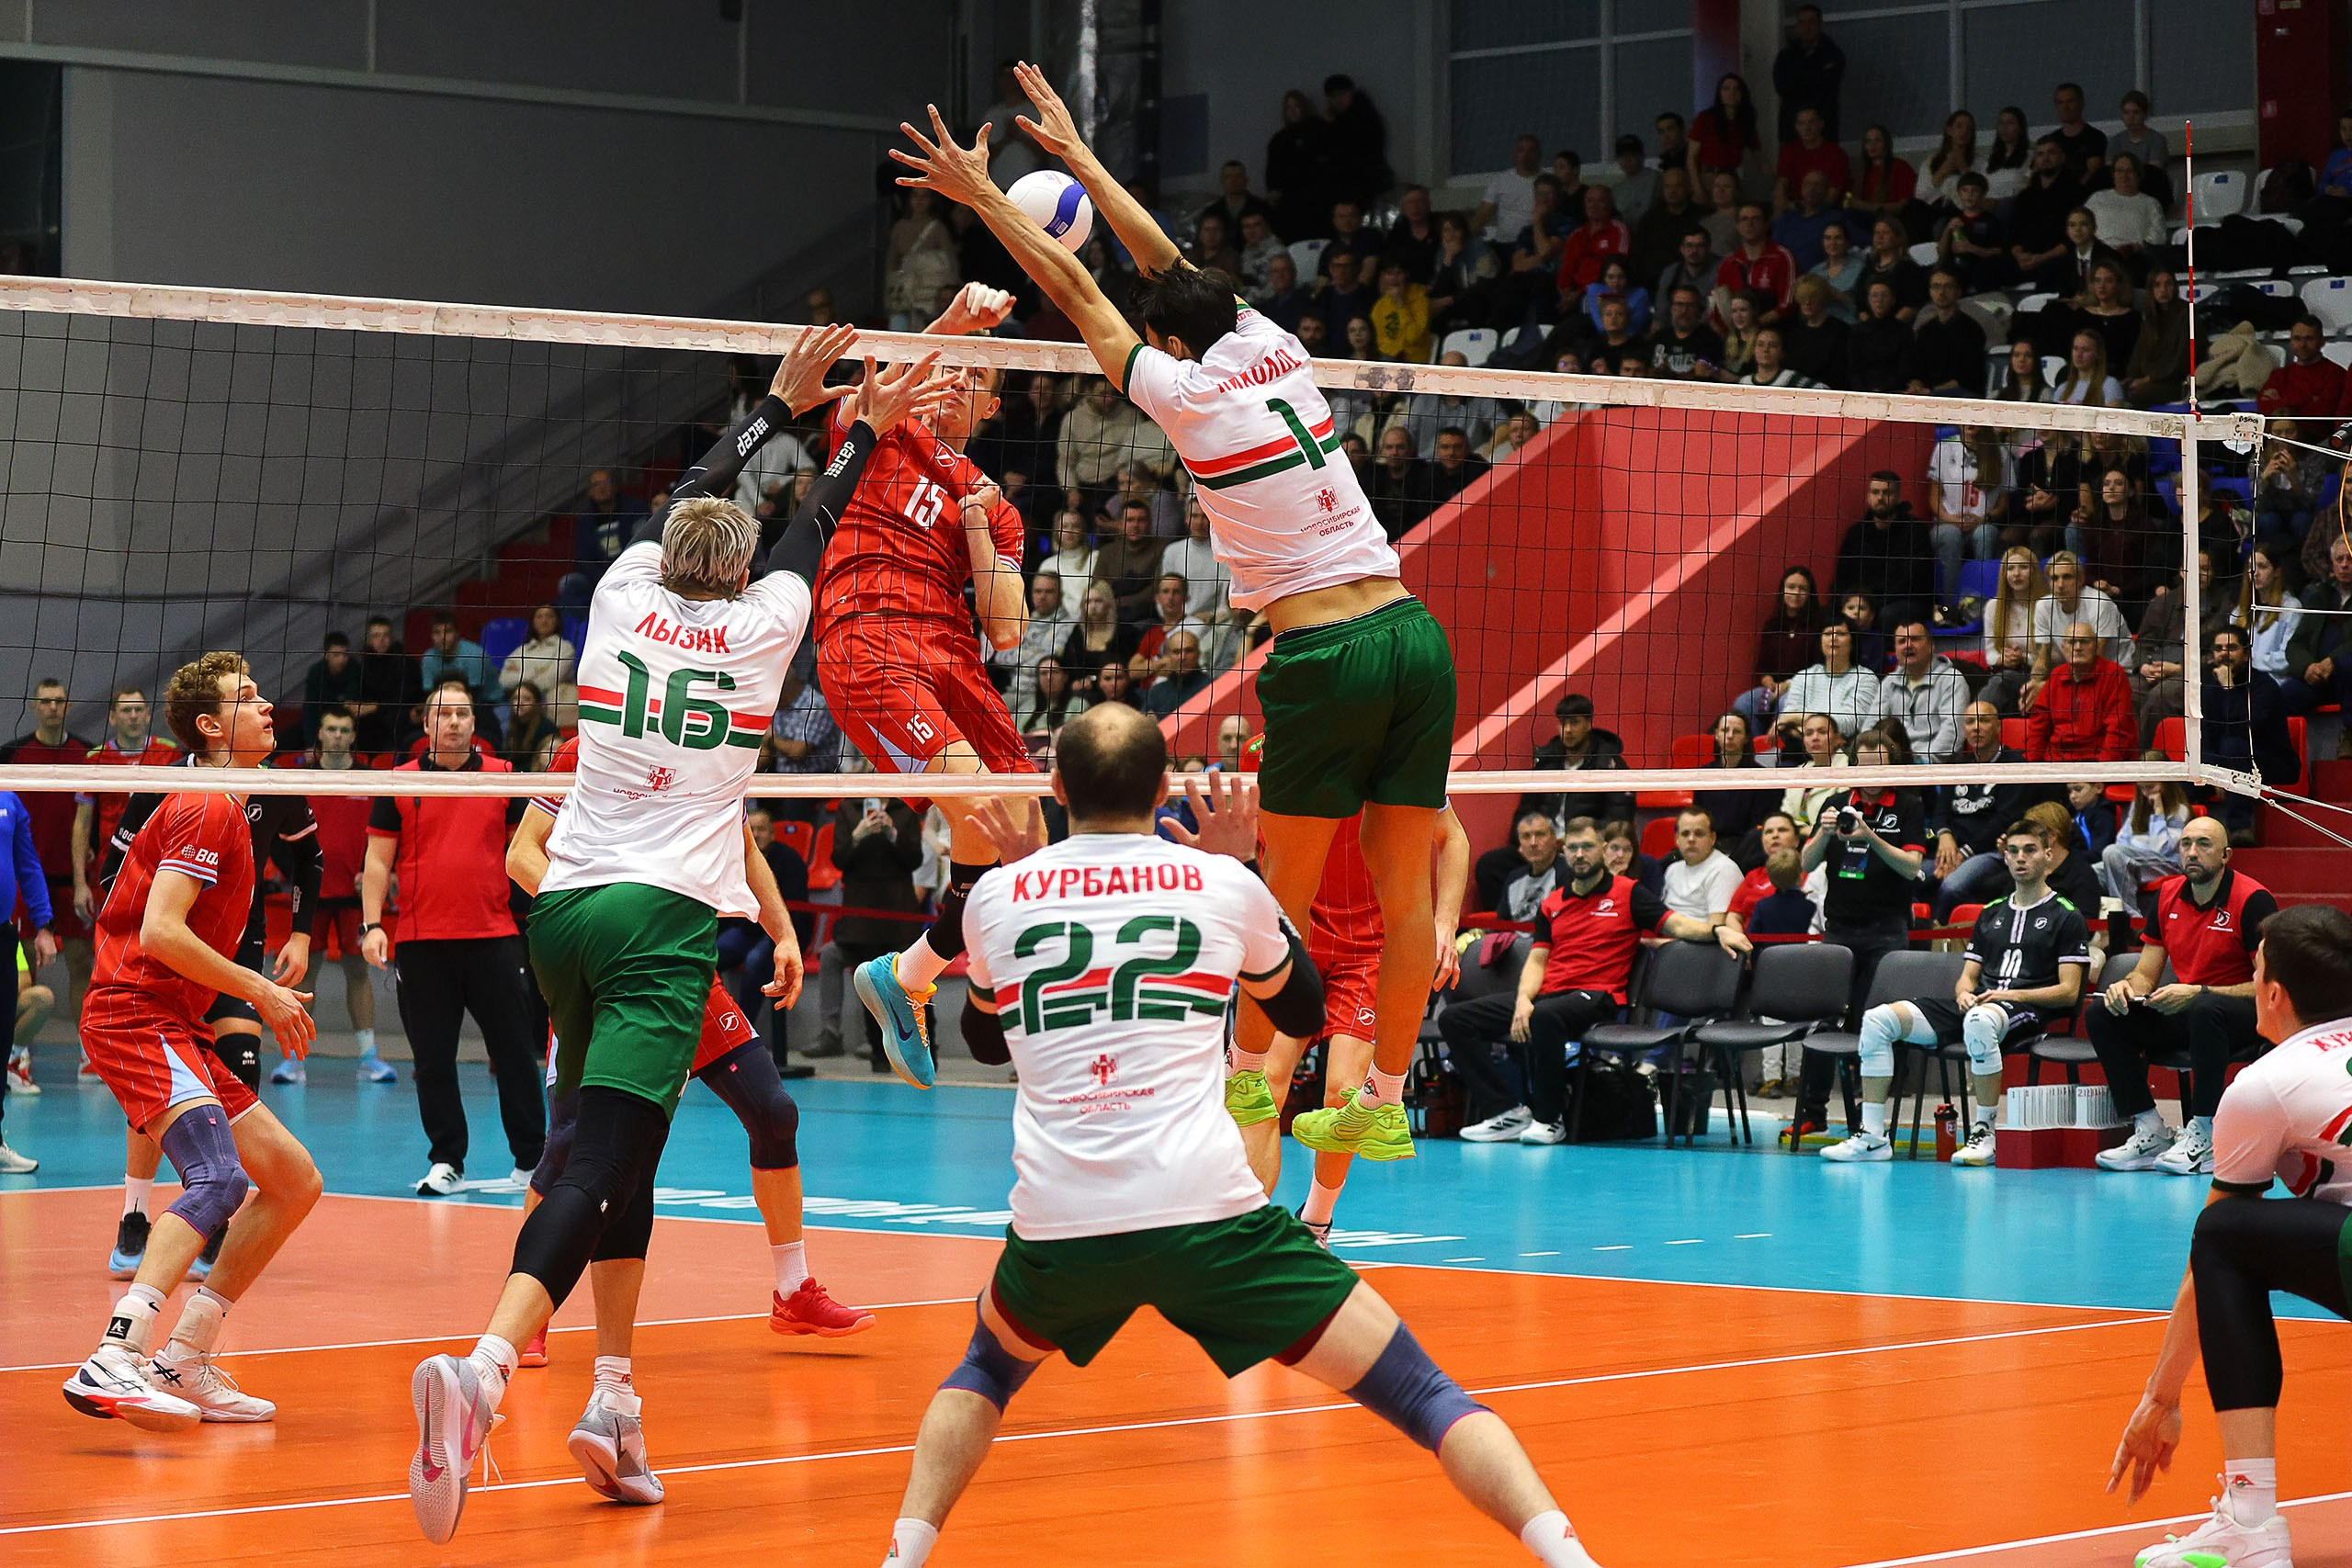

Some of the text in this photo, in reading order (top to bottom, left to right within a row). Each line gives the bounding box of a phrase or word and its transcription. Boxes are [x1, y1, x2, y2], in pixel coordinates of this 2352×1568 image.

[838, 441, 856, 468] cep
[1266, 398, 1326, 470] 1
[904, 474, 948, 529] 15
[1318, 520, 1354, 537] ОБЛАСТЬ
[634, 611, 731, 653] ЛЫЗИК
[617, 650, 737, 750] 16
[906, 714, 934, 745] 15
[1012, 863, 1204, 903] КУРБАНОВ
[1014, 915, 1202, 1036] 22
[1999, 948, 2023, 978] 10
